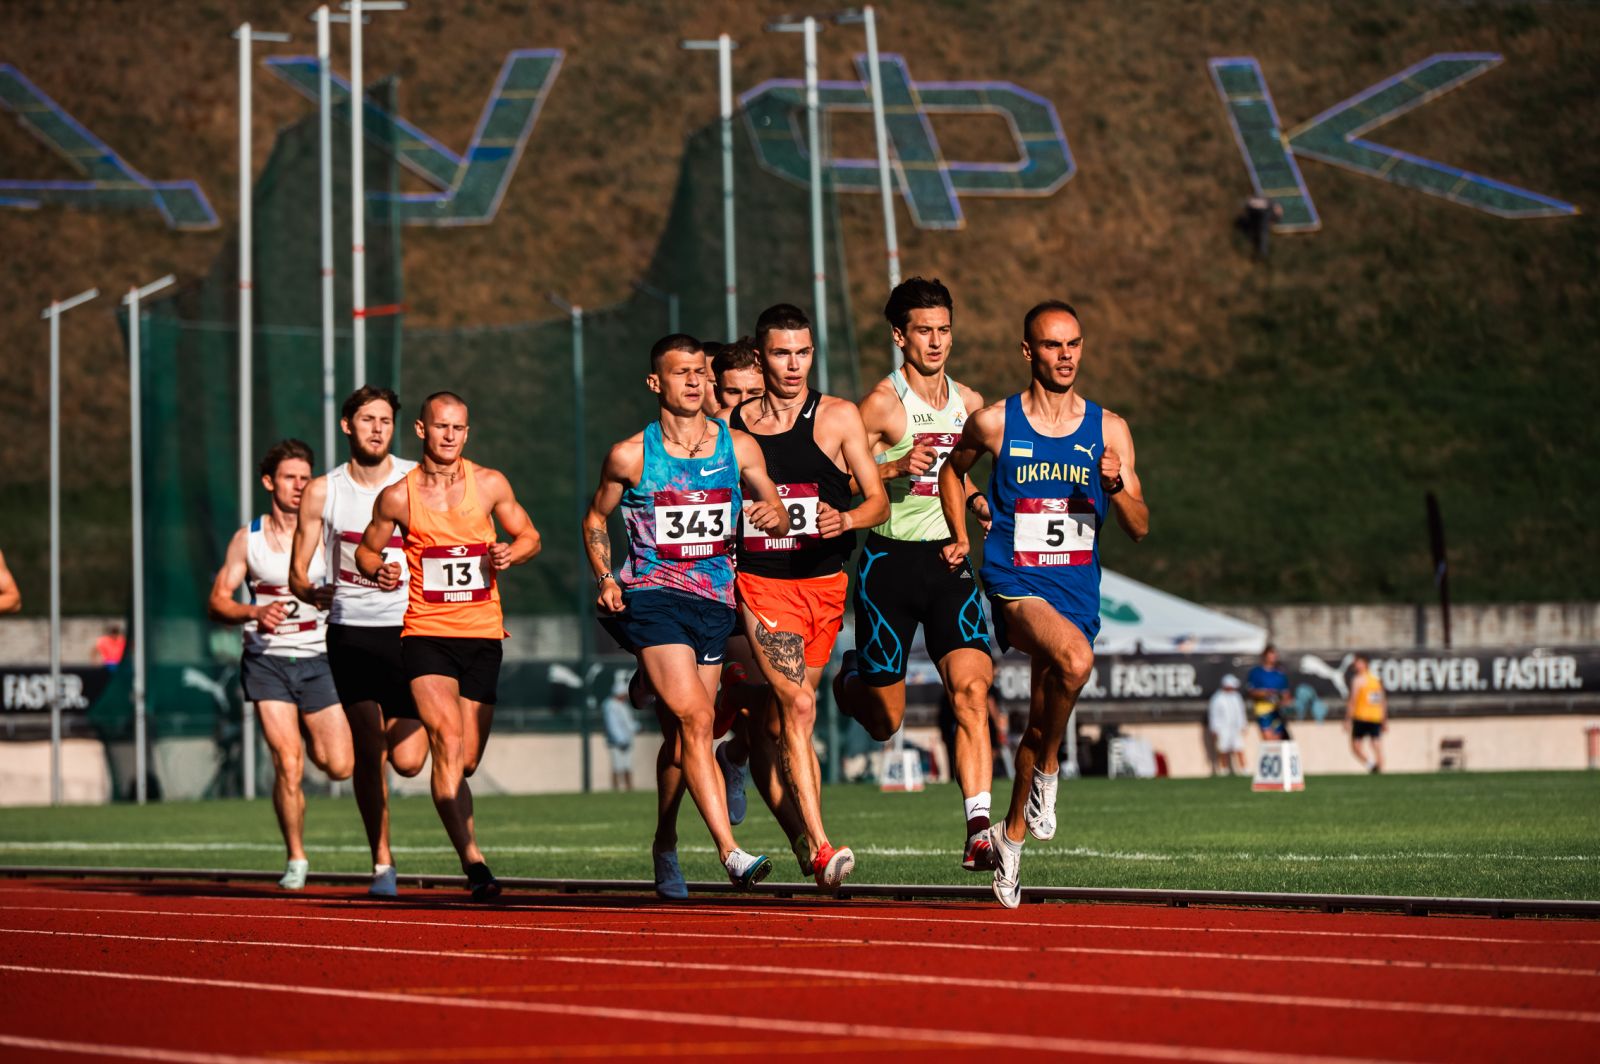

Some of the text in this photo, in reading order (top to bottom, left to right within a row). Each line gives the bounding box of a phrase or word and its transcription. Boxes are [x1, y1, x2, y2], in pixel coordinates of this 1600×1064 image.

[912, 412, 935, 423] DLK
[1016, 462, 1091, 486] UKRAINE
[665, 508, 724, 539] 343
[1045, 518, 1065, 547] 5
[681, 544, 714, 557] PUMA
[765, 537, 797, 549] PUMA
[1038, 553, 1071, 565] PUMA
[442, 562, 472, 587] 13
[443, 591, 473, 603] PUMA
[1110, 664, 1203, 697] FASTER.
[1367, 656, 1583, 691] FOREVER. FASTER.
[1259, 754, 1283, 778] 60
